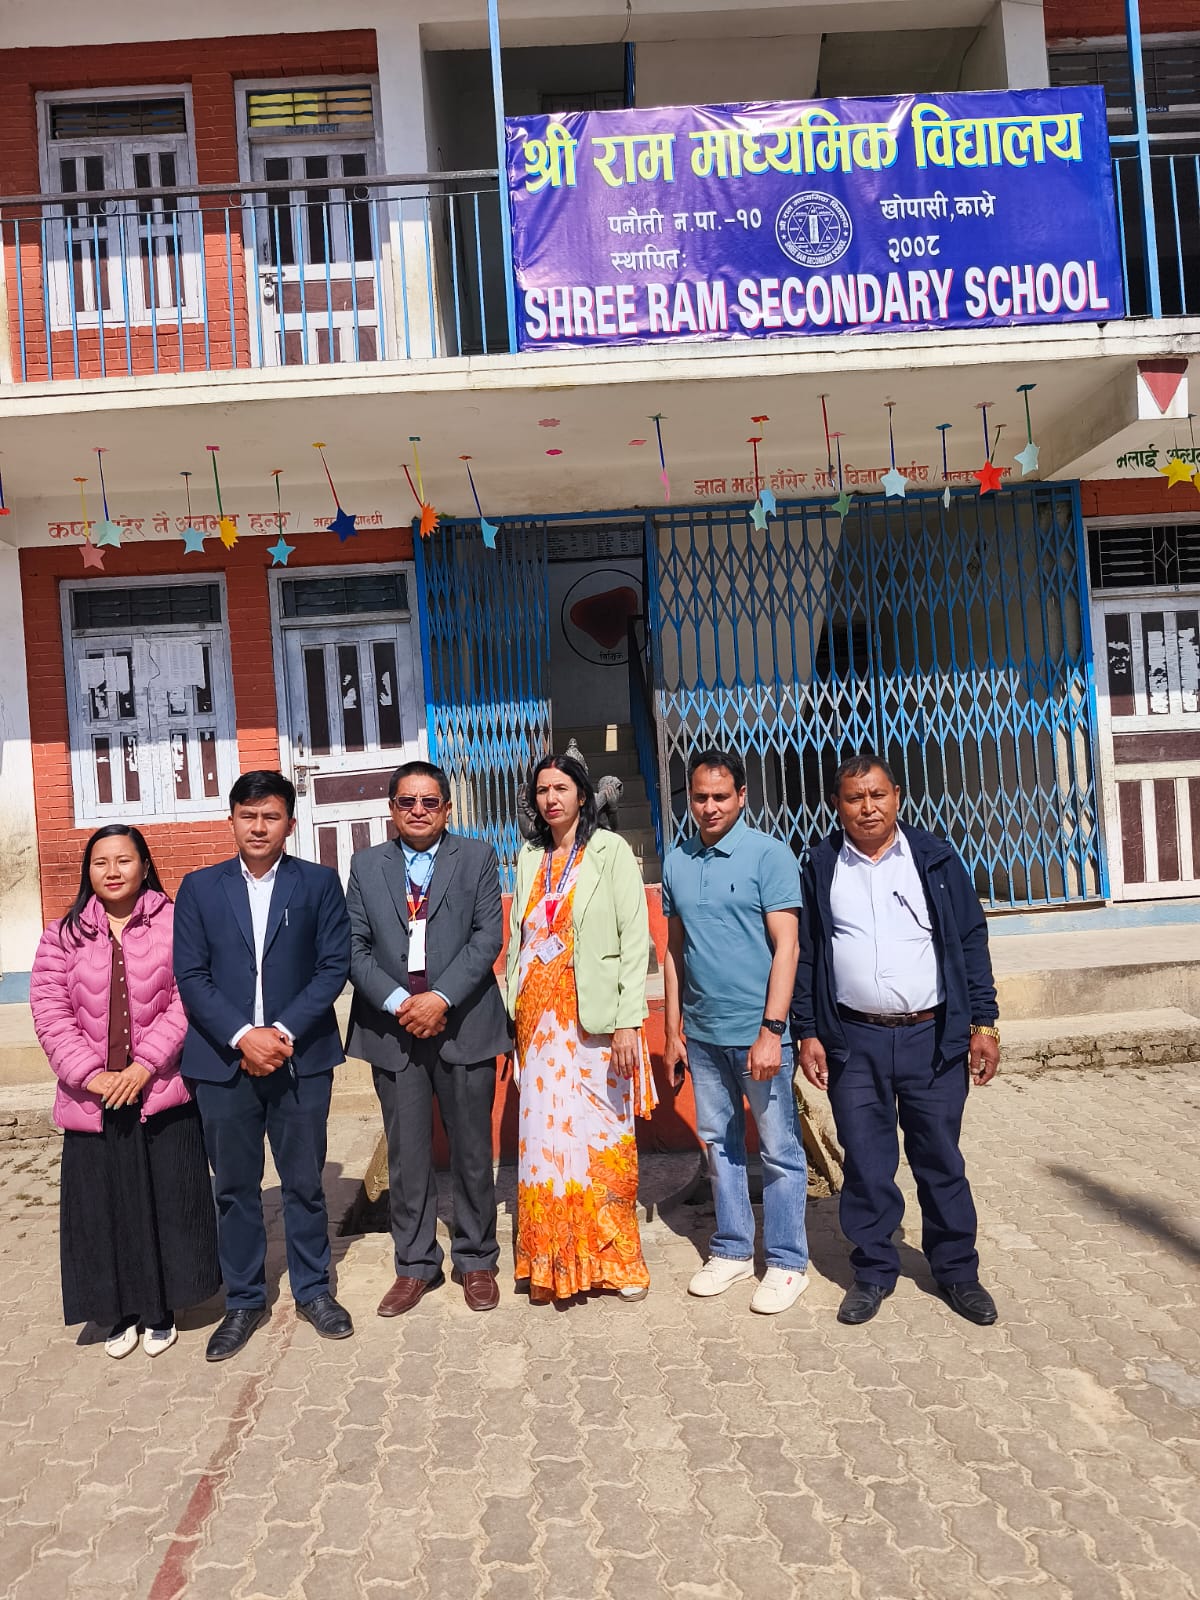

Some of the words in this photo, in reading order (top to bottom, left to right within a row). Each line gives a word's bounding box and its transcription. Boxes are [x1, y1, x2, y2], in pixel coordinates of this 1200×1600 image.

[522, 122, 577, 194] श्री
[591, 133, 676, 187] राम
[689, 107, 898, 179] माध्यमिक
[911, 102, 1084, 169] विद्यालय
[607, 206, 665, 235] पनौती
[888, 235, 940, 263] २००८
[524, 285, 638, 340] SHREE
[648, 281, 729, 333] RAM
[738, 269, 953, 329] SECONDARY
[965, 260, 1110, 319] SCHOOL
